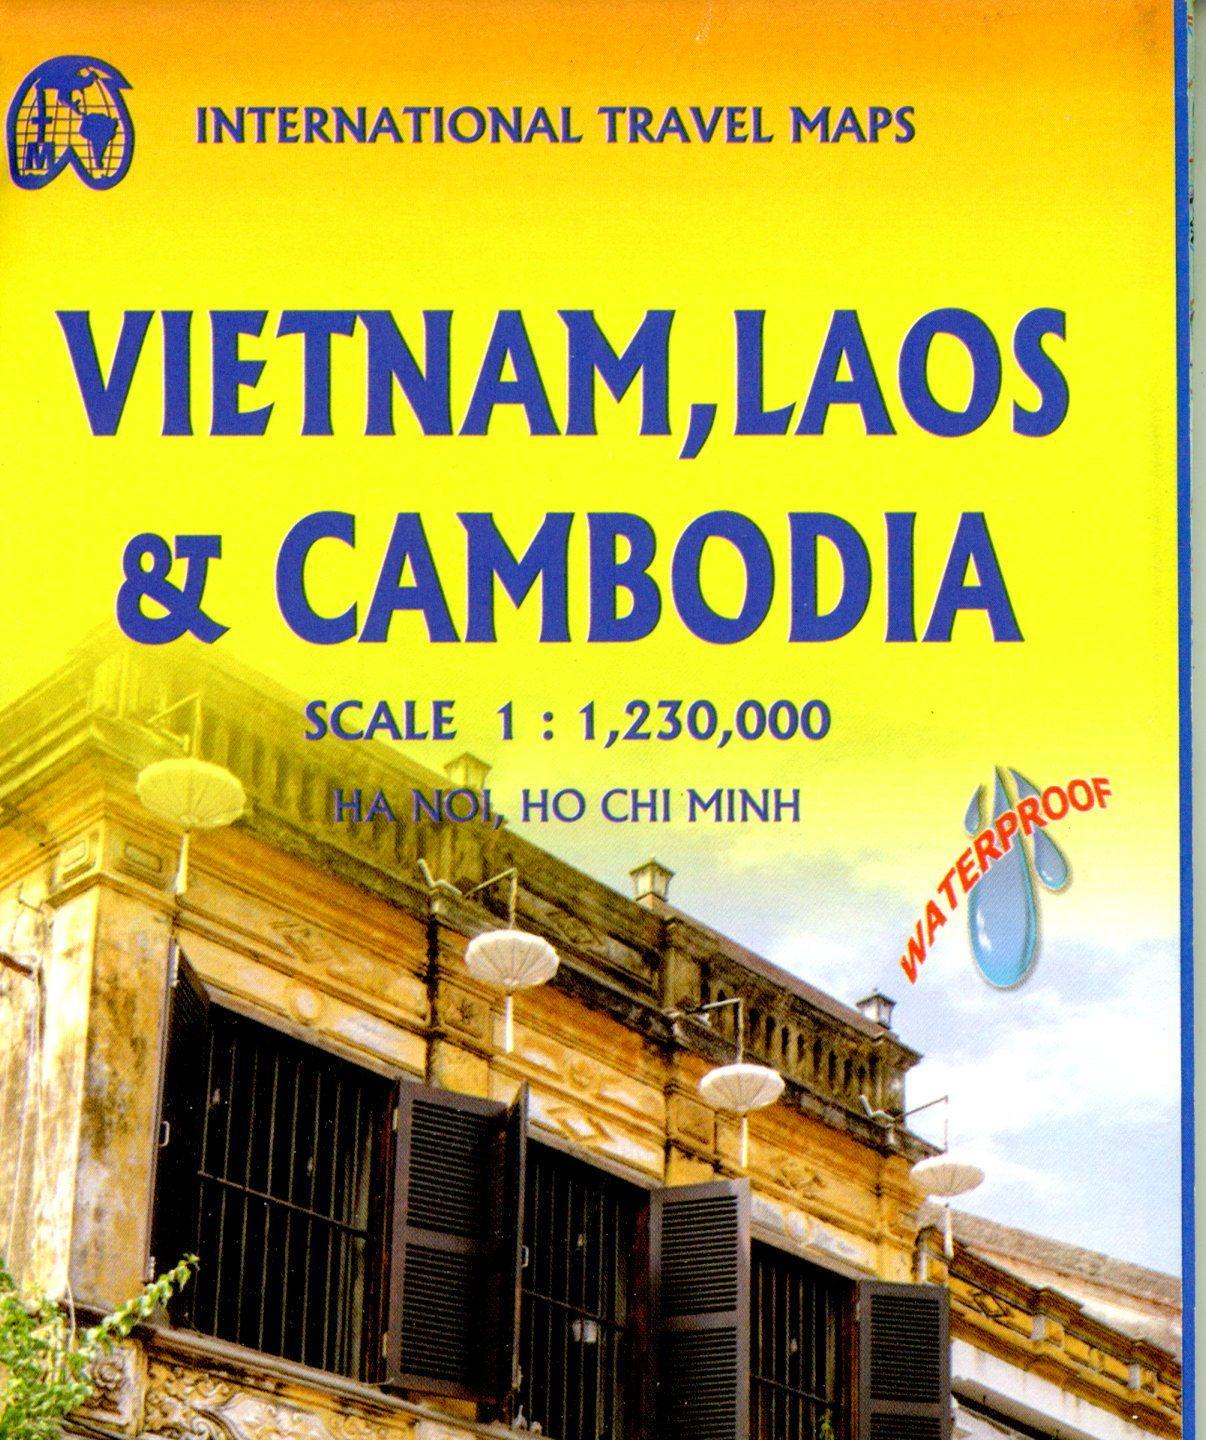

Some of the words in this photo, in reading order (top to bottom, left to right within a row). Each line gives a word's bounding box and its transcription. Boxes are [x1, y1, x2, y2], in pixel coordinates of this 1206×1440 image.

[196, 105, 584, 144] INTERNATIONAL
[598, 106, 775, 144] TRAVEL
[789, 105, 917, 144] MAPS
[116, 533, 228, 645] &
[275, 511, 1023, 645] CAMBODIA
[304, 699, 457, 741] SCALE
[496, 701, 515, 740] 1
[580, 699, 832, 748] 1,230,000
[334, 788, 396, 822] HA
[411, 788, 505, 830] NOI,
[521, 788, 586, 823] HO
[600, 788, 671, 823] CHI
[687, 788, 801, 823] MINH
[900, 777, 1113, 985] WATERPROOF
